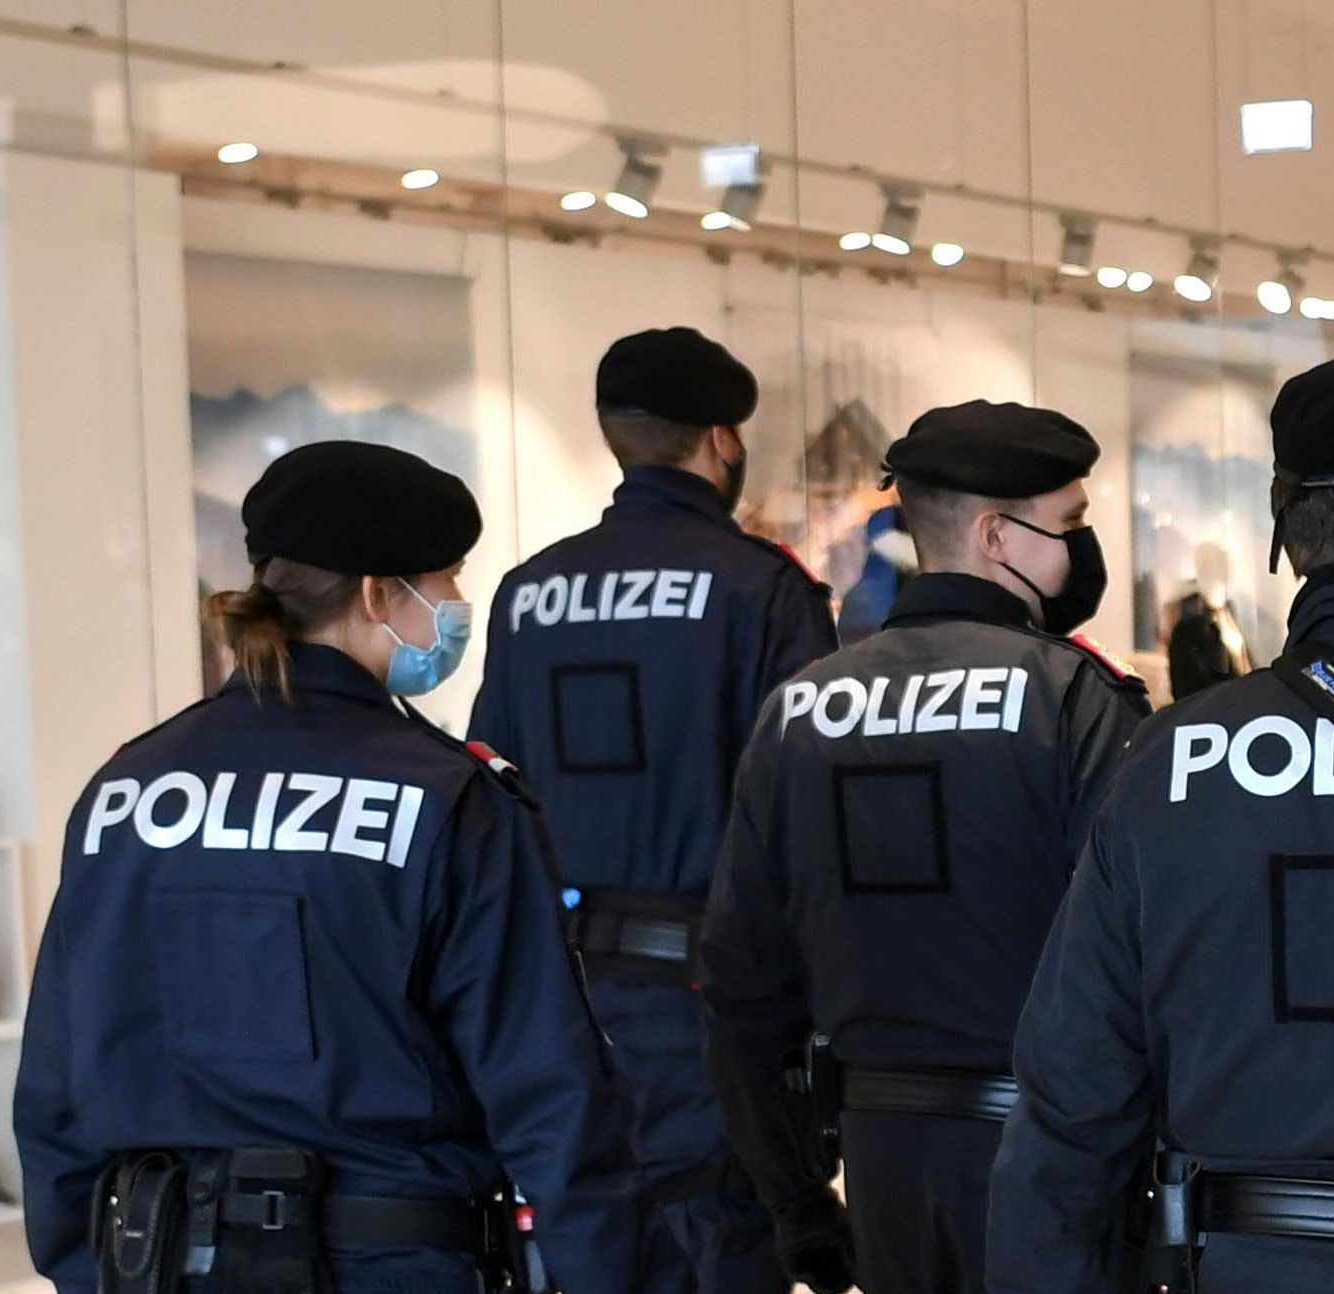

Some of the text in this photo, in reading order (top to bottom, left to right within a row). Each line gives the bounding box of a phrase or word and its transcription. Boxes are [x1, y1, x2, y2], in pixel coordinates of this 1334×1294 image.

[510, 569, 713, 632] POLIZEI
[780, 666, 1029, 739] POLIZEI
[83, 771, 425, 868] POLIZEI
